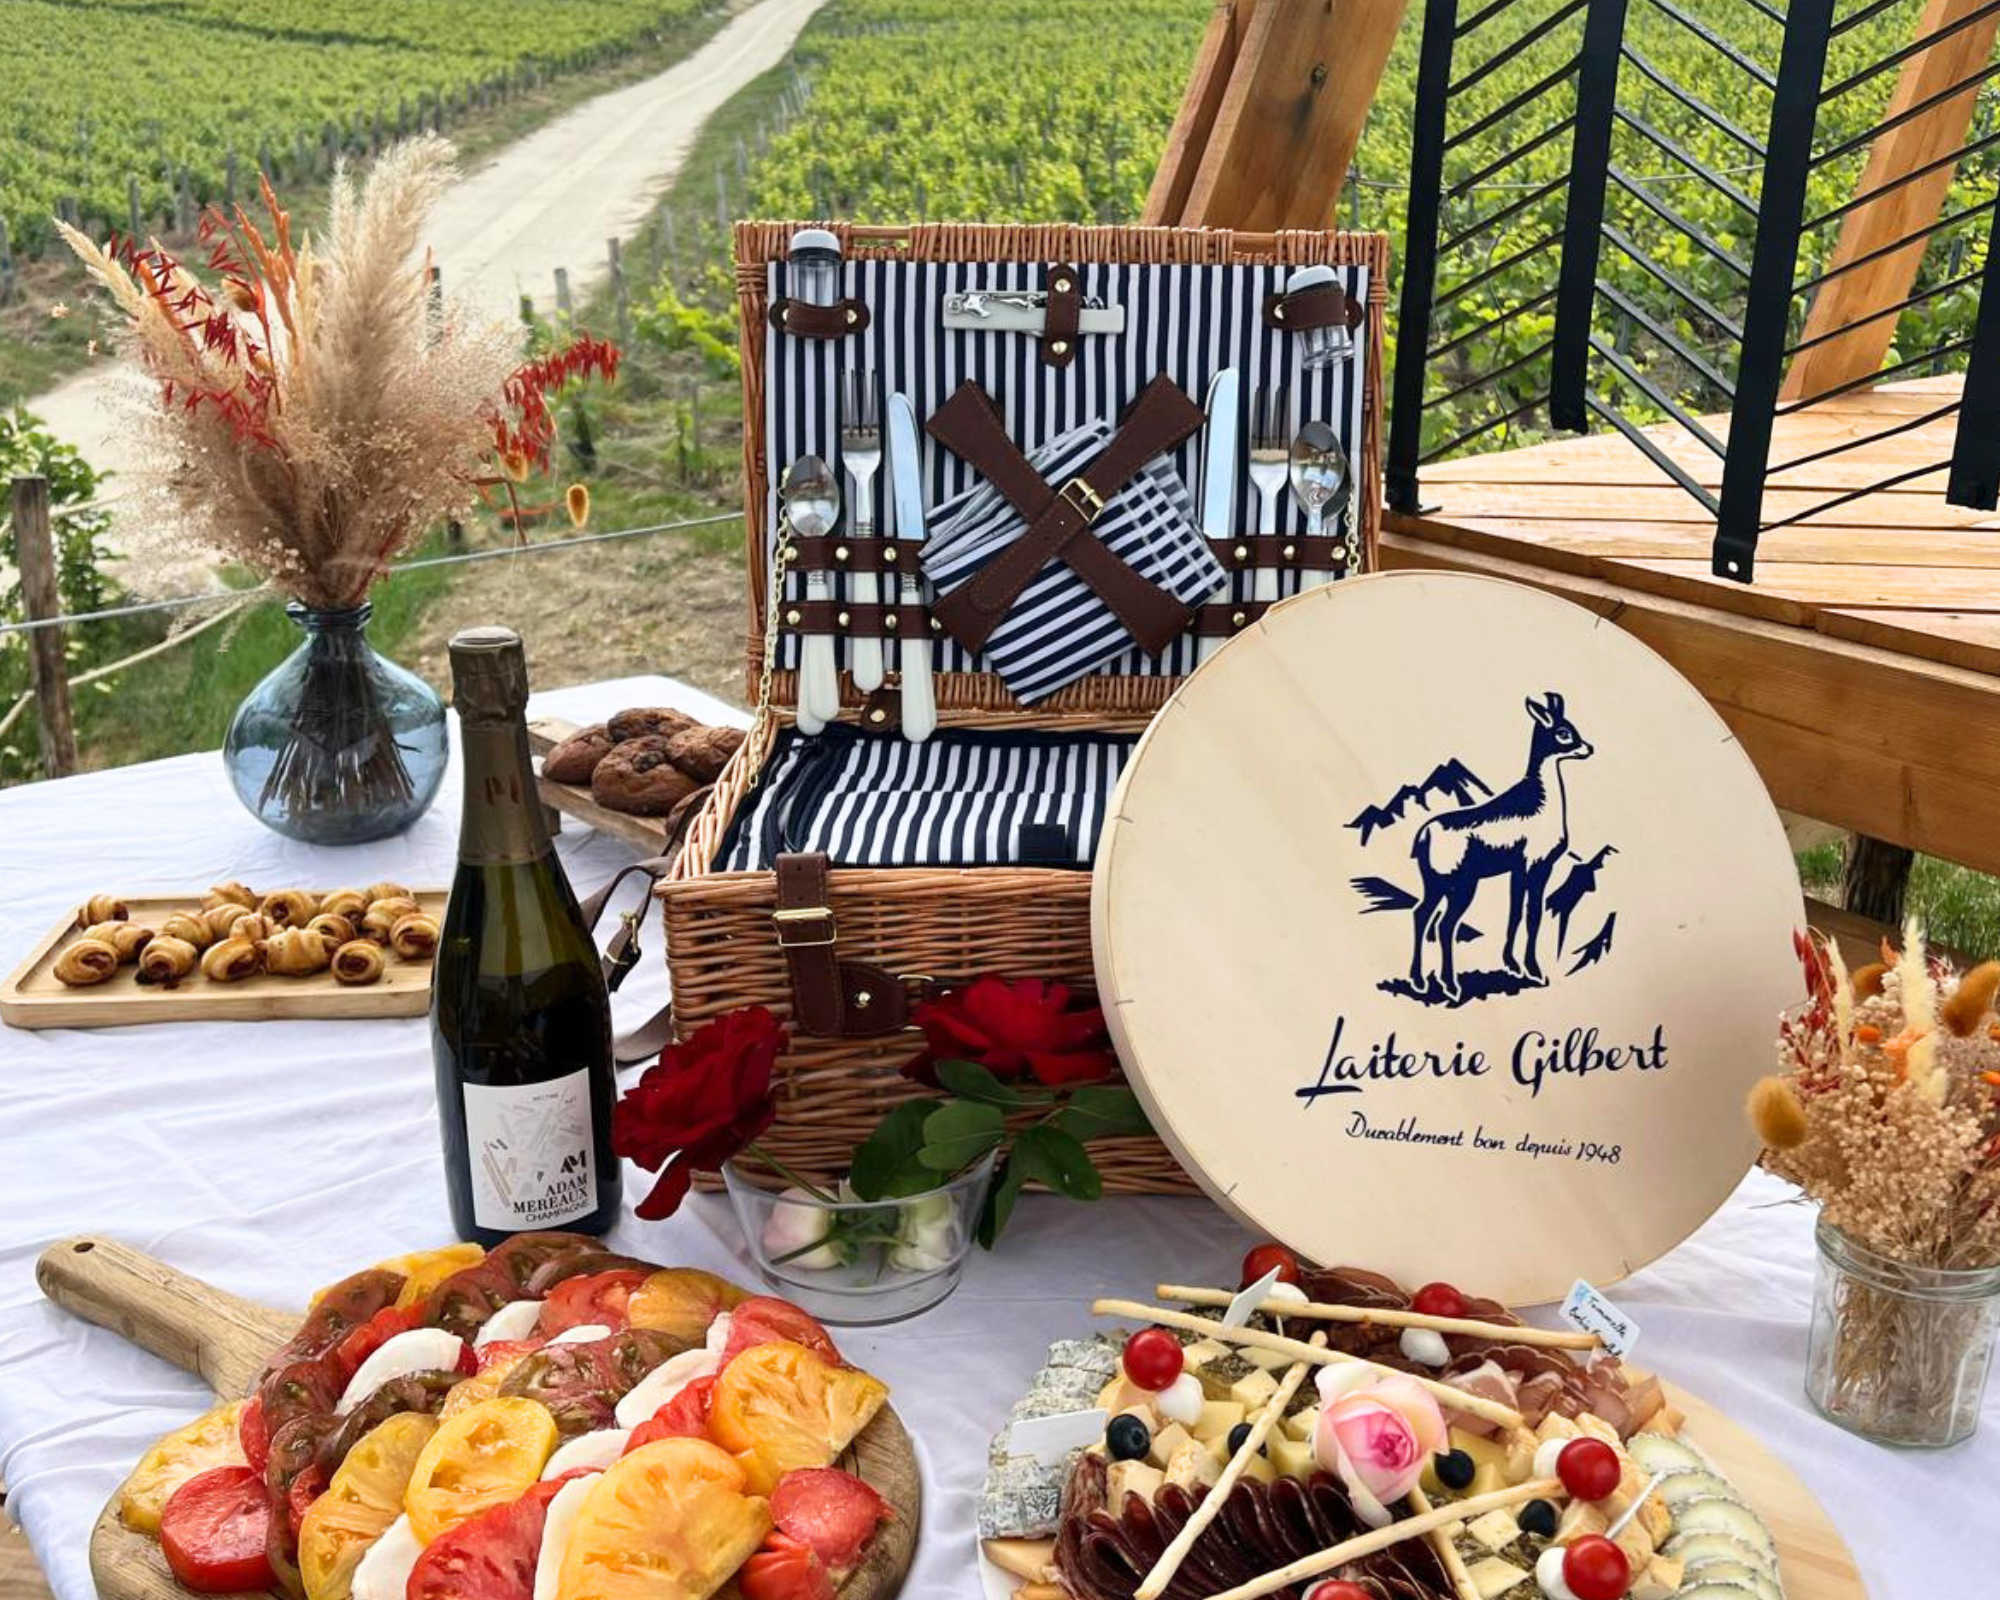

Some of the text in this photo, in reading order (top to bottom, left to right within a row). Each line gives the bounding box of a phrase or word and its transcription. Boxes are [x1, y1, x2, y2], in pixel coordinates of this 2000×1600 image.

[1295, 1016, 1669, 1109] Laiterie Gilbert
[1345, 1111, 1622, 1164] Durablement bon depuis 1948
[546, 1172, 588, 1198] ADAM
[513, 1187, 589, 1214] MEREAUX
[526, 1199, 589, 1223] CHAMPAGNE
